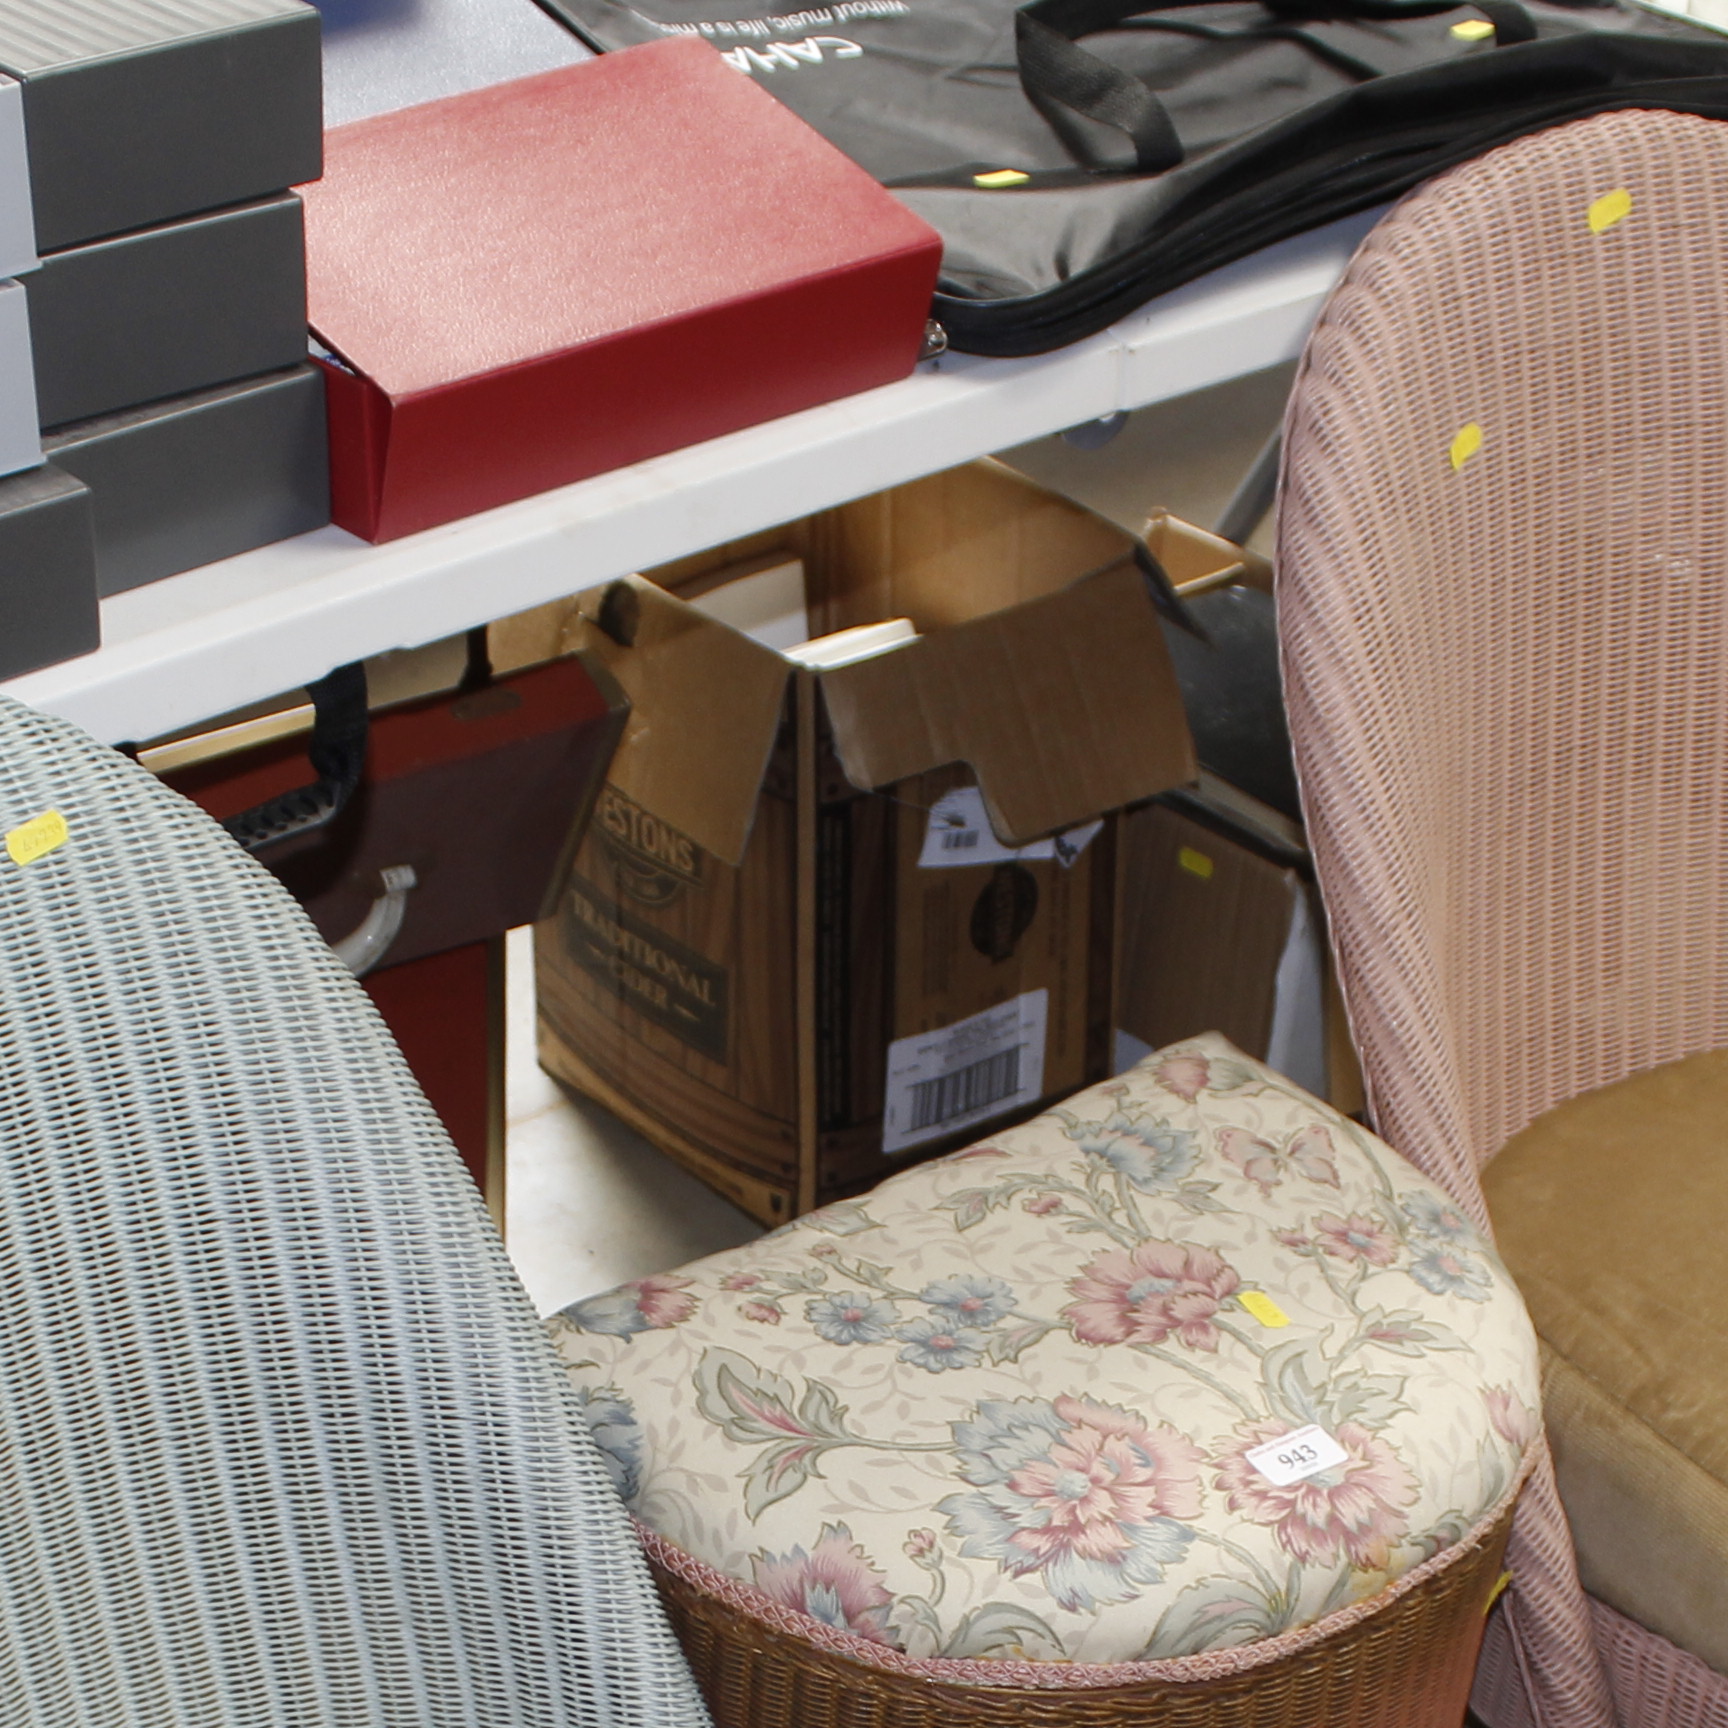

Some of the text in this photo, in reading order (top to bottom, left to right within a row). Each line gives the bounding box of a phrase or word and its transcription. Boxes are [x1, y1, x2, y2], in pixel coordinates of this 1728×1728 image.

[698, 21, 716, 37] a
[718, 21, 738, 36] is
[736, 18, 771, 38] life
[771, 8, 834, 32] music,
[720, 36, 864, 74] CAHA
[596, 789, 694, 872] ESTONS
[572, 888, 716, 1007] TRADITIONAL
[1277, 1444, 1318, 1470] 943
